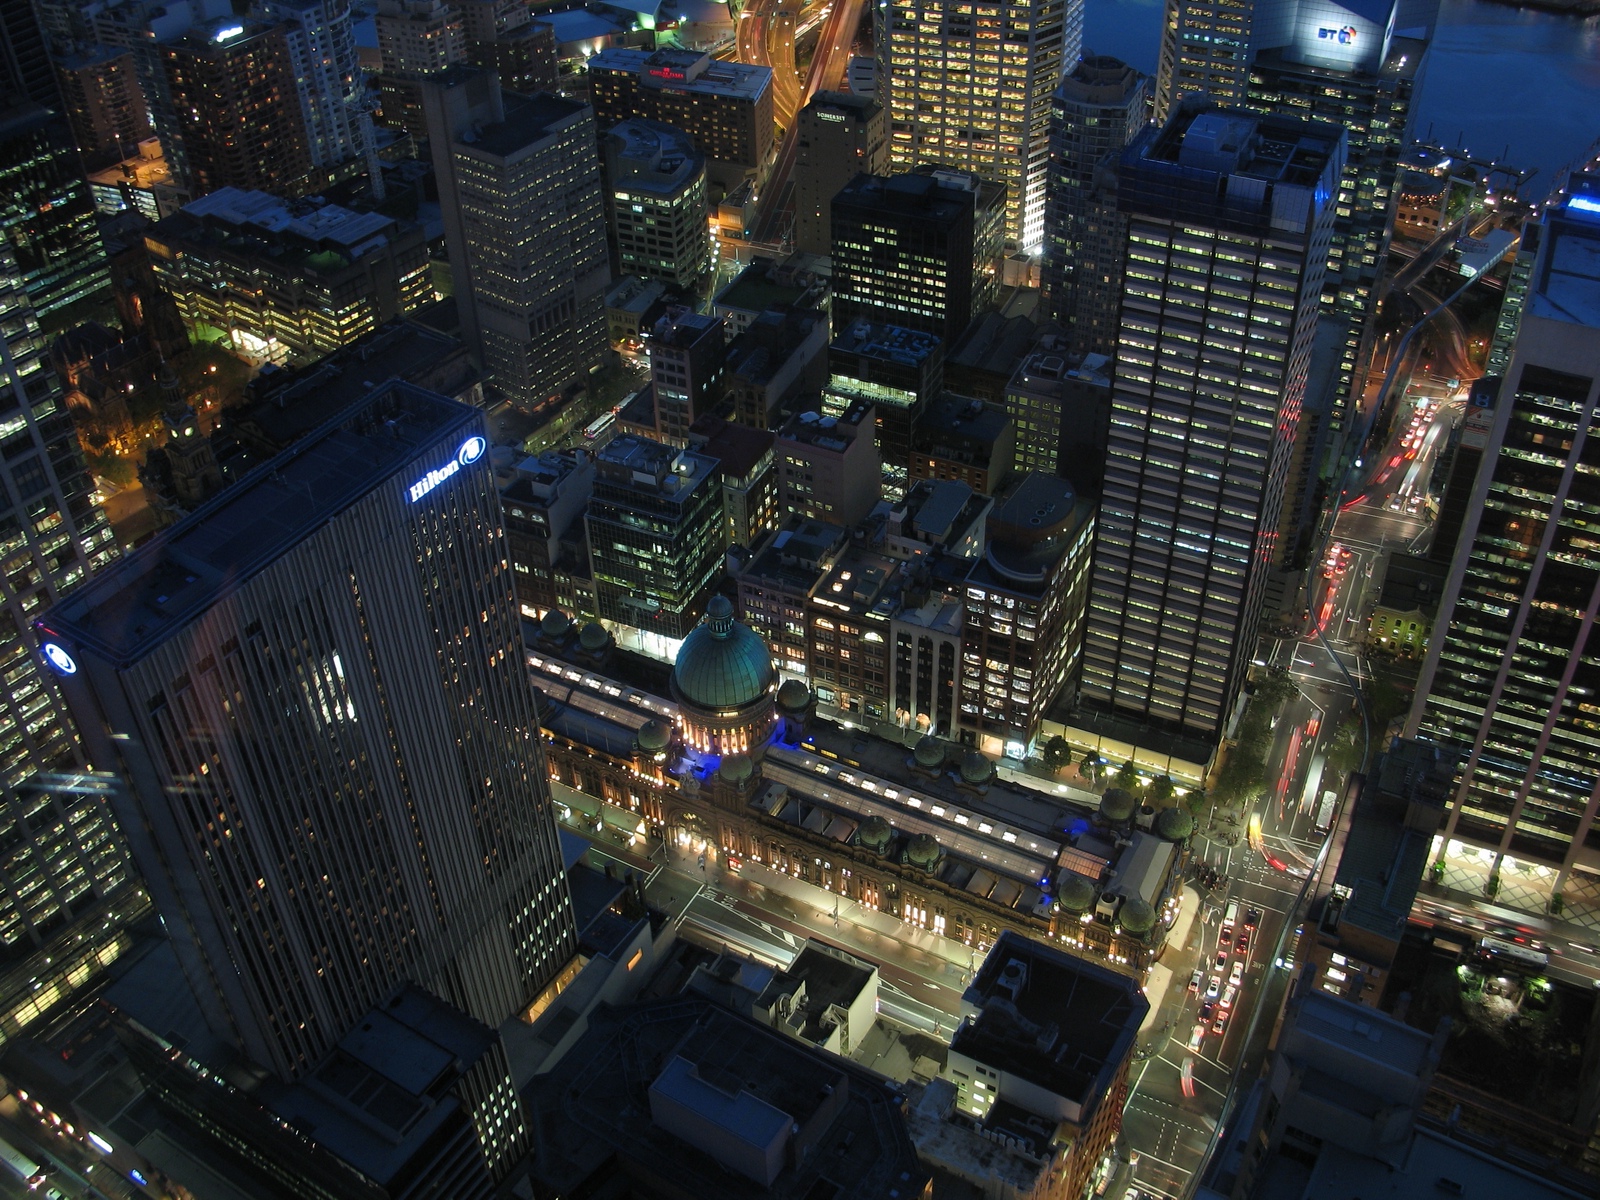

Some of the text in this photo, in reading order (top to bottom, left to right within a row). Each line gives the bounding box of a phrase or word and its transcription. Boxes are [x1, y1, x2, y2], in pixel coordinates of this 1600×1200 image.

[1318, 28, 1337, 40] BT
[816, 111, 846, 122] SOMERSET
[409, 459, 460, 503] Hilton
